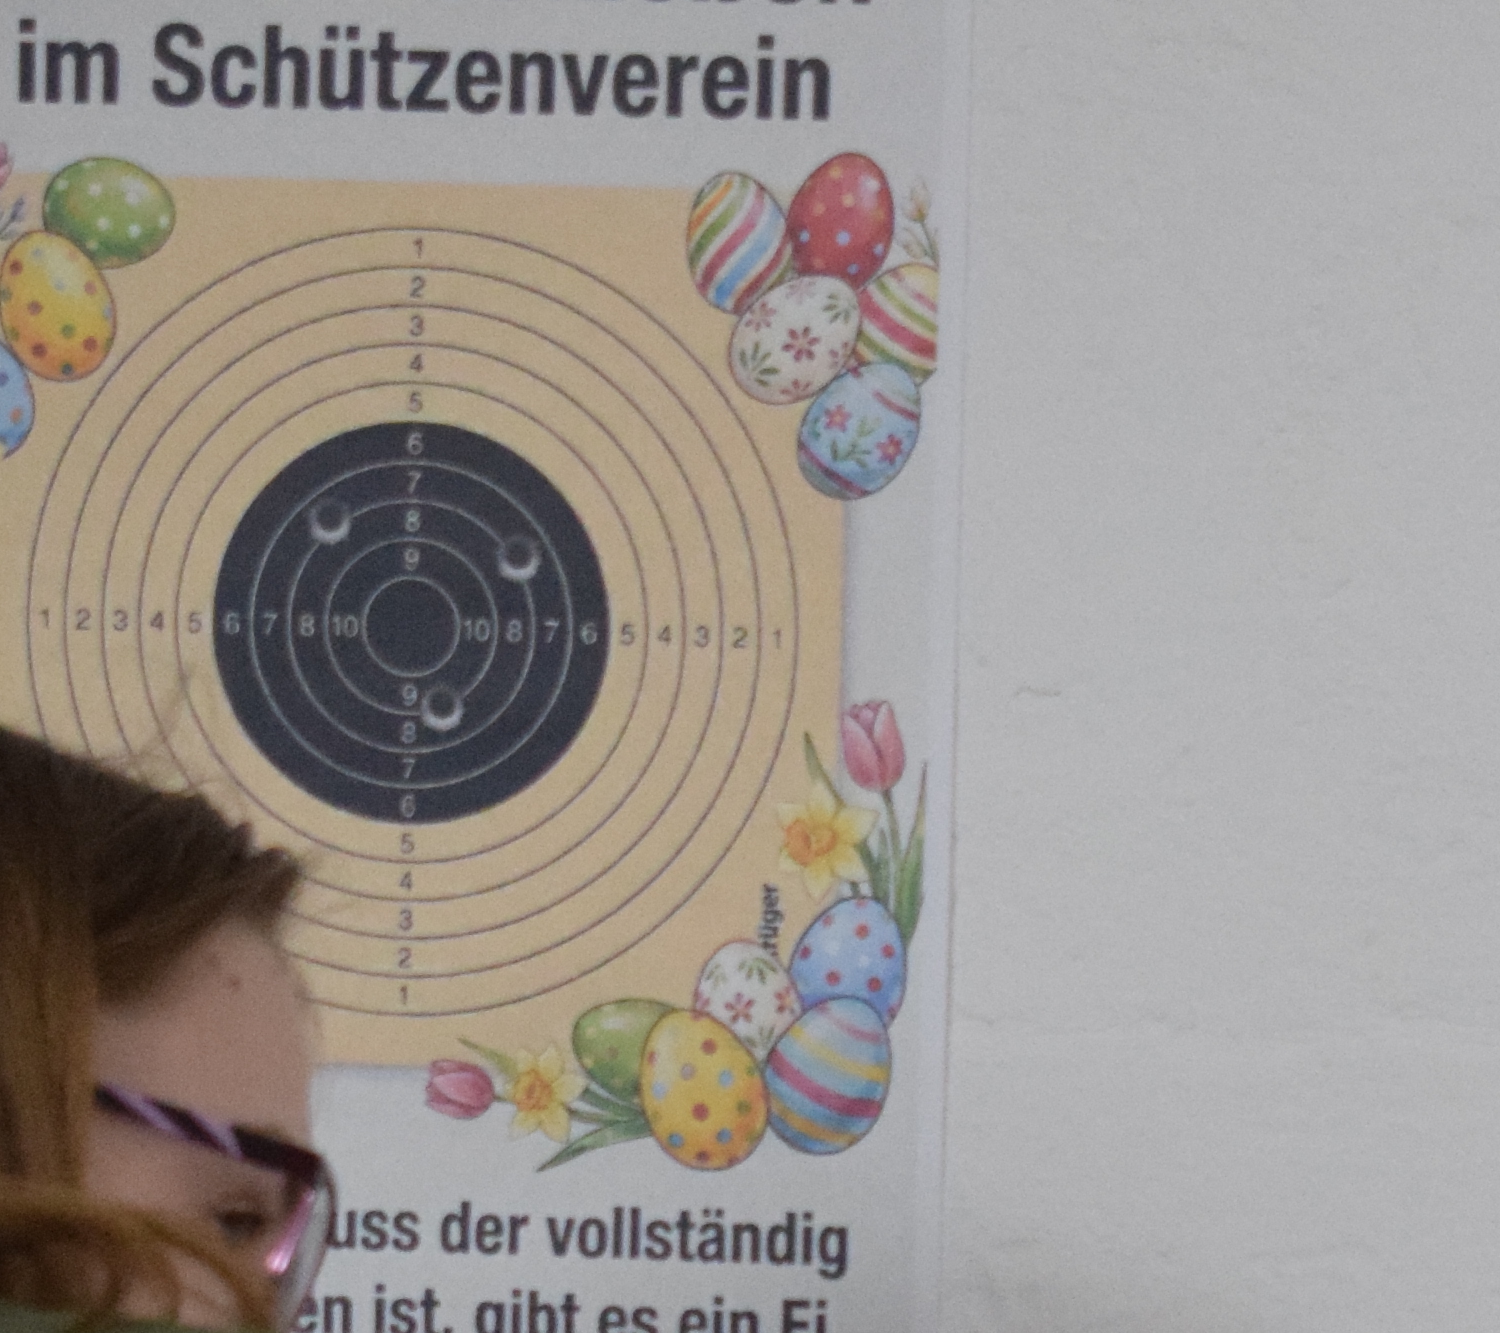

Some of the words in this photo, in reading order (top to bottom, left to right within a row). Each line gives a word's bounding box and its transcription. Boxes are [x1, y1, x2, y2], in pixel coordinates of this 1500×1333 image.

[17, 18, 120, 105] im
[152, 21, 832, 120] Schützenverein
[413, 238, 423, 257] 1
[410, 276, 425, 298] 2
[410, 314, 424, 337] 3
[410, 354, 423, 374] 4
[410, 391, 423, 412] 5
[407, 432, 421, 454] 6
[409, 471, 421, 493] 7
[406, 510, 419, 531] 8
[405, 549, 419, 570] 9
[40, 608, 49, 627] 1
[75, 608, 91, 630] 2
[113, 609, 128, 631] 3
[150, 611, 164, 632] 4
[188, 611, 202, 634] 5
[223, 612, 240, 633] 6
[263, 612, 278, 634] 7
[300, 614, 315, 636] 8
[333, 616, 358, 635] 10
[465, 619, 490, 641] 10
[506, 619, 522, 642] 8
[545, 619, 559, 642] 7
[580, 623, 597, 644] 6
[621, 623, 635, 645] 5
[658, 625, 671, 646] 4
[695, 625, 709, 648] 3
[732, 626, 748, 648] 2
[773, 628, 781, 648] 1
[402, 684, 417, 705] 9
[401, 721, 415, 743] 8
[400, 759, 415, 780] 7
[401, 795, 414, 818] 6
[401, 833, 414, 854] 5
[400, 871, 412, 892] 4
[399, 909, 412, 931] 3
[758, 883, 784, 957] rüger
[398, 947, 411, 968] 2
[400, 985, 408, 1004] 1
[440, 1201, 529, 1255] der
[546, 1206, 849, 1280] vollständig
